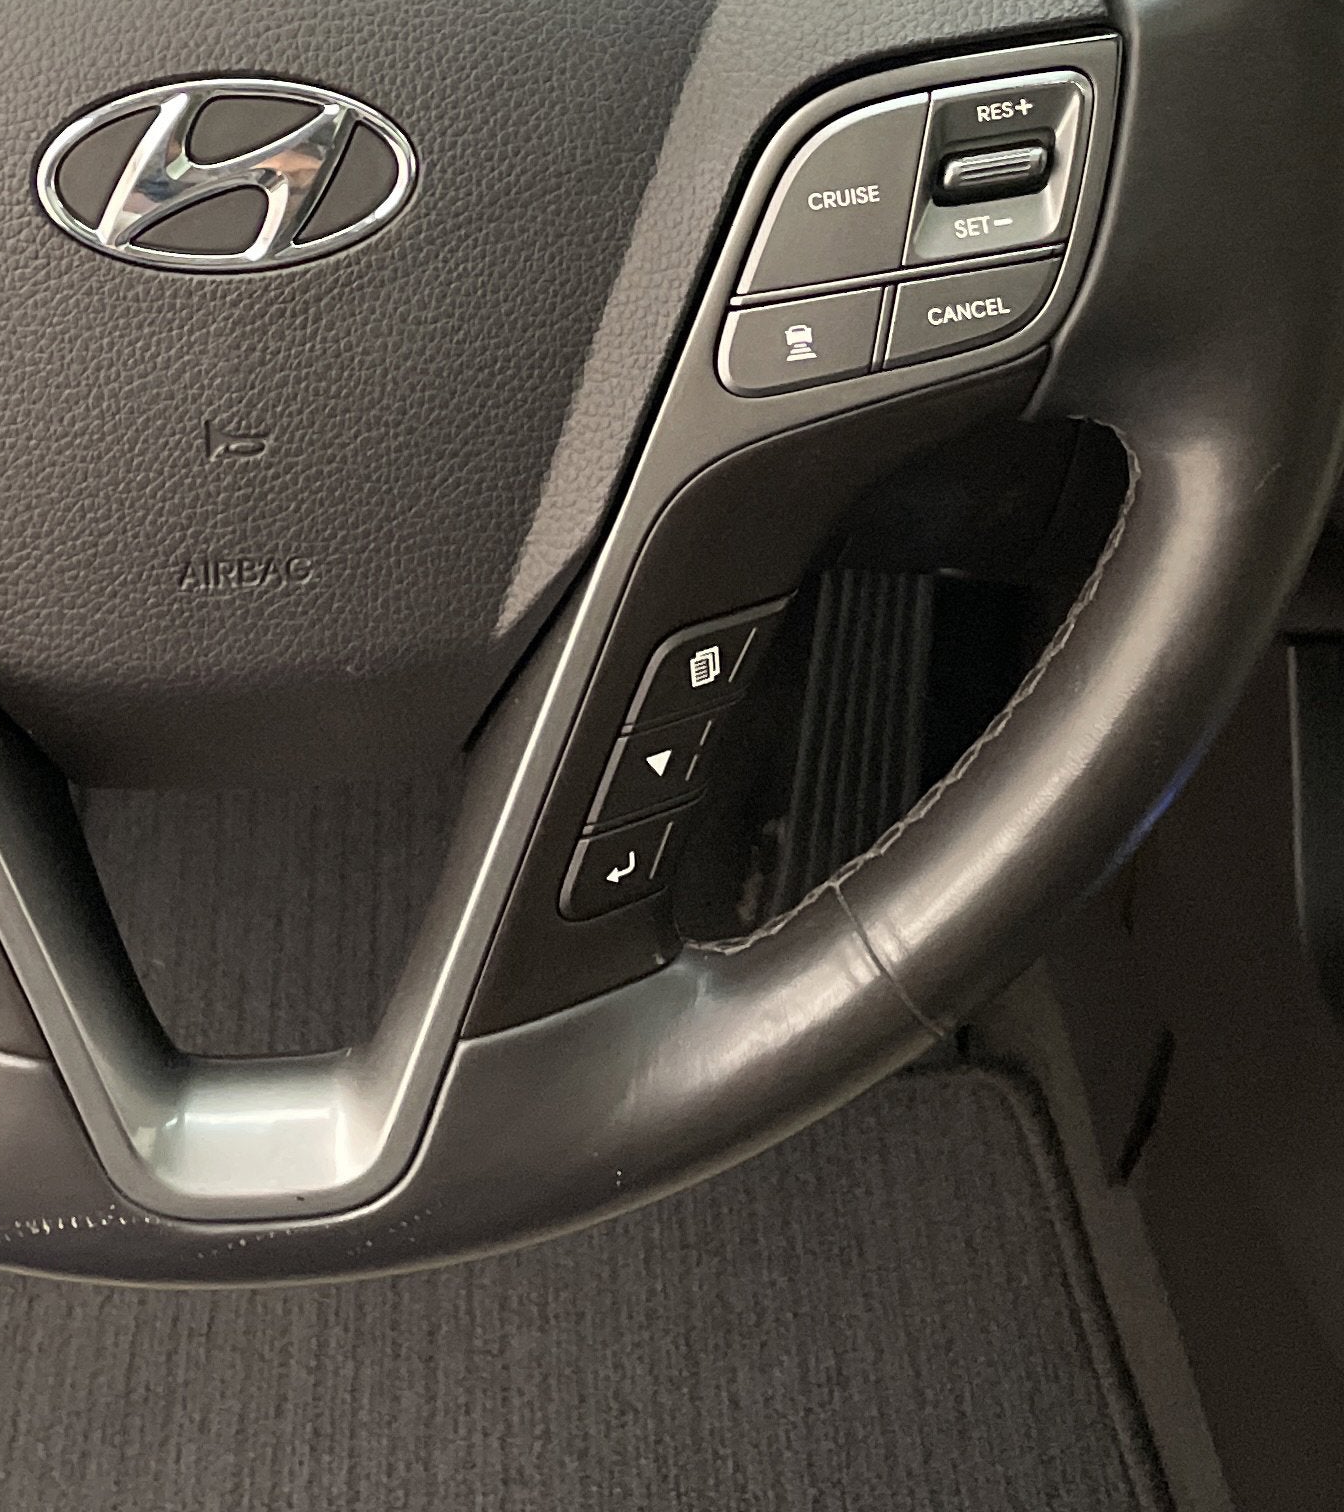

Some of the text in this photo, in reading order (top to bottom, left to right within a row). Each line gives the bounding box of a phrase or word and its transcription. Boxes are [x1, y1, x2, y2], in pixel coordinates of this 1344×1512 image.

[808, 185, 881, 211] CRUISE
[927, 298, 1011, 326] CANCEL
[177, 557, 315, 589] AIRBAG
